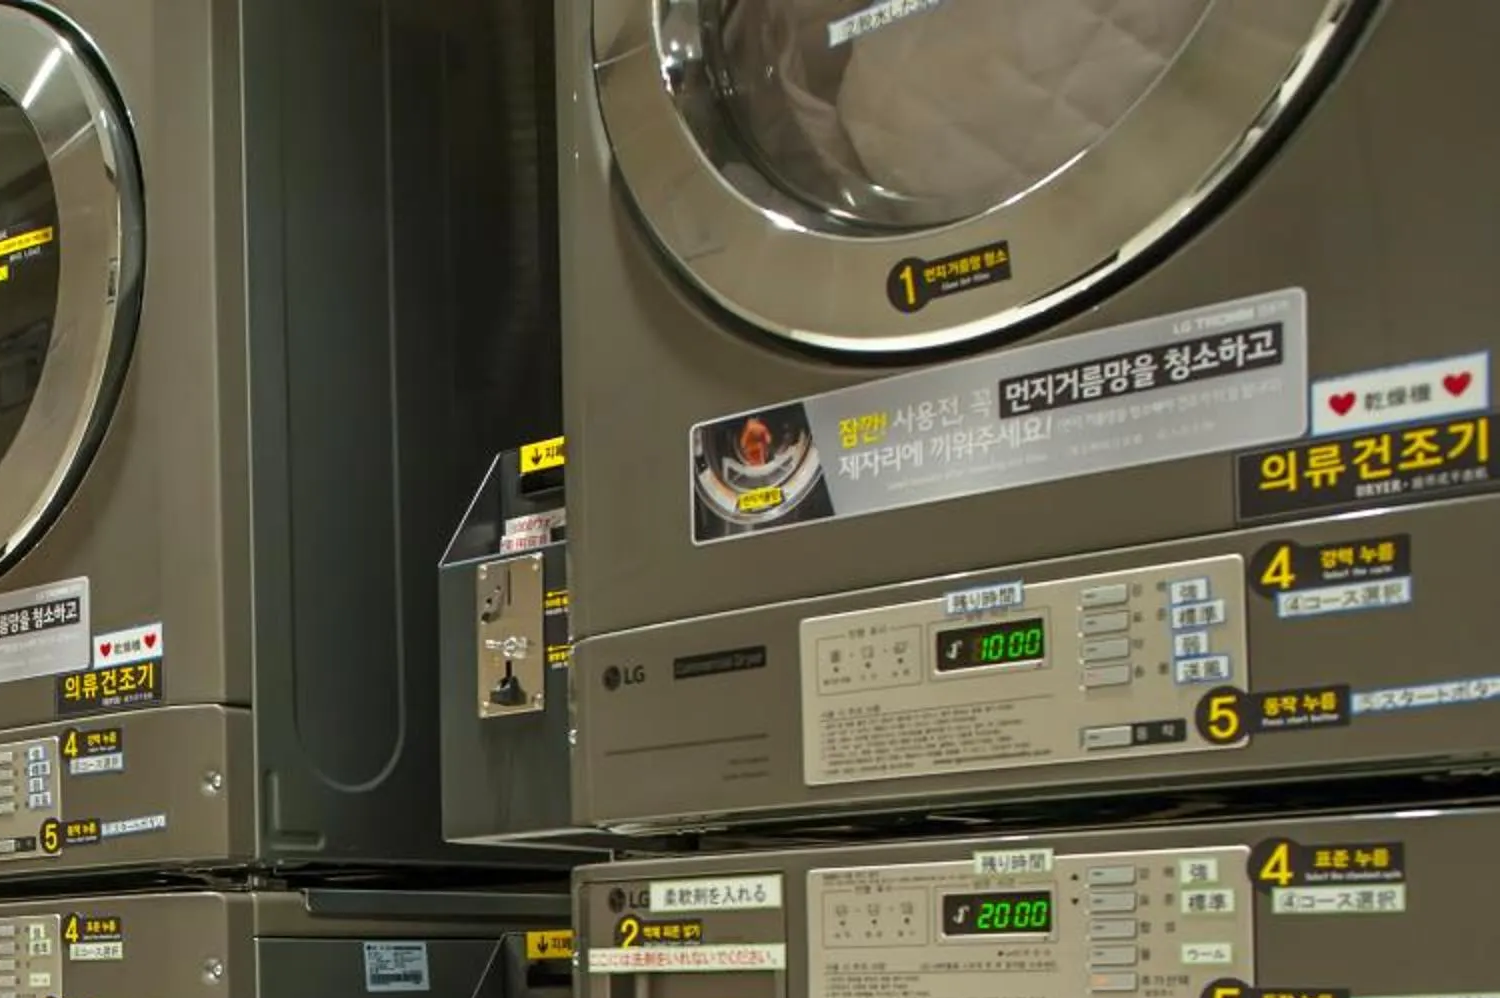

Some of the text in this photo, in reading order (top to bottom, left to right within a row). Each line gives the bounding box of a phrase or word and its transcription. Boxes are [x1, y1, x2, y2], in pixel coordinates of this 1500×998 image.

[900, 266, 915, 305] 1
[1006, 354, 1158, 414] 먼지거름망을
[1164, 330, 1277, 381] 청소하고
[838, 441, 924, 481] 제자리에
[930, 414, 1053, 459] 끼워주세요!
[1258, 417, 1489, 492] 의류건조기
[1261, 545, 1296, 589] 4
[32, 600, 78, 629] 청소하고
[980, 628, 1041, 661] 1000
[64, 662, 154, 701] 의류건조기
[623, 664, 646, 685] LG
[1208, 695, 1240, 739] 5
[63, 731, 78, 758] 4
[44, 822, 58, 850] 5
[1259, 842, 1295, 886] 4
[629, 890, 651, 908] LG
[977, 901, 1048, 929] 2000
[64, 916, 79, 943] 4
[620, 917, 640, 949] 2
